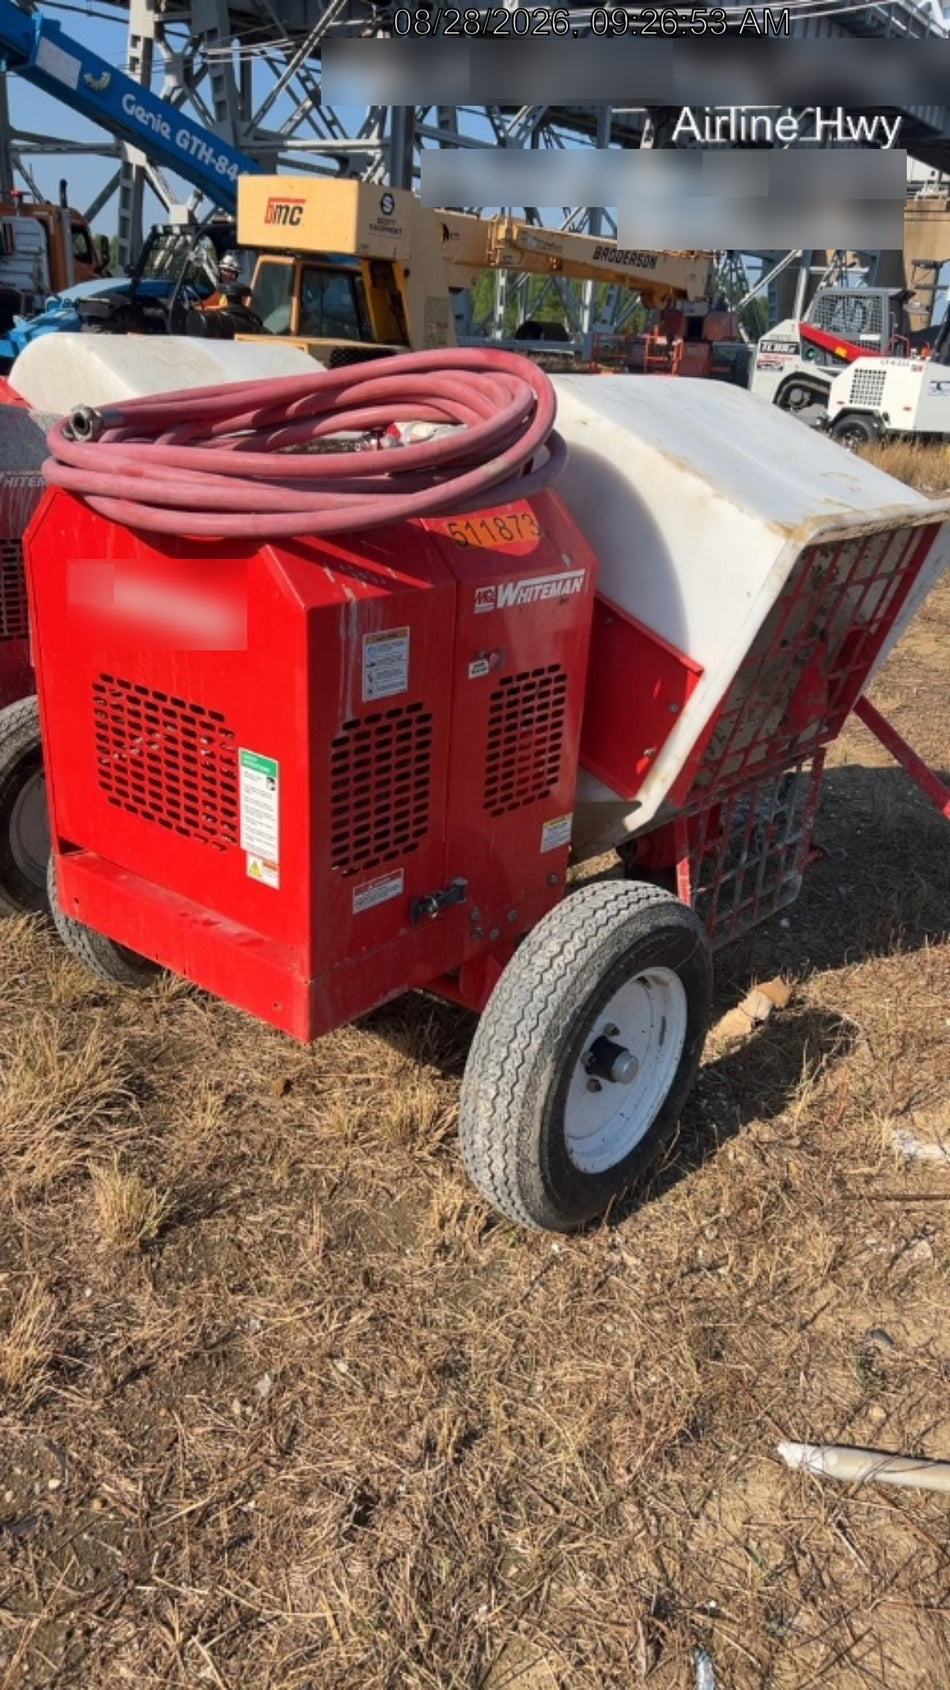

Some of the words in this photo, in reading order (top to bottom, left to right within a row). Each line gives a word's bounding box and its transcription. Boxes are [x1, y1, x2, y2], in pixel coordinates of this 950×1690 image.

[121, 93, 172, 140] Genie
[175, 129, 249, 182] GTH-84
[593, 245, 658, 269] BRODERSON
[447, 513, 542, 547] 511873
[497, 571, 585, 609] WHITEMAN
